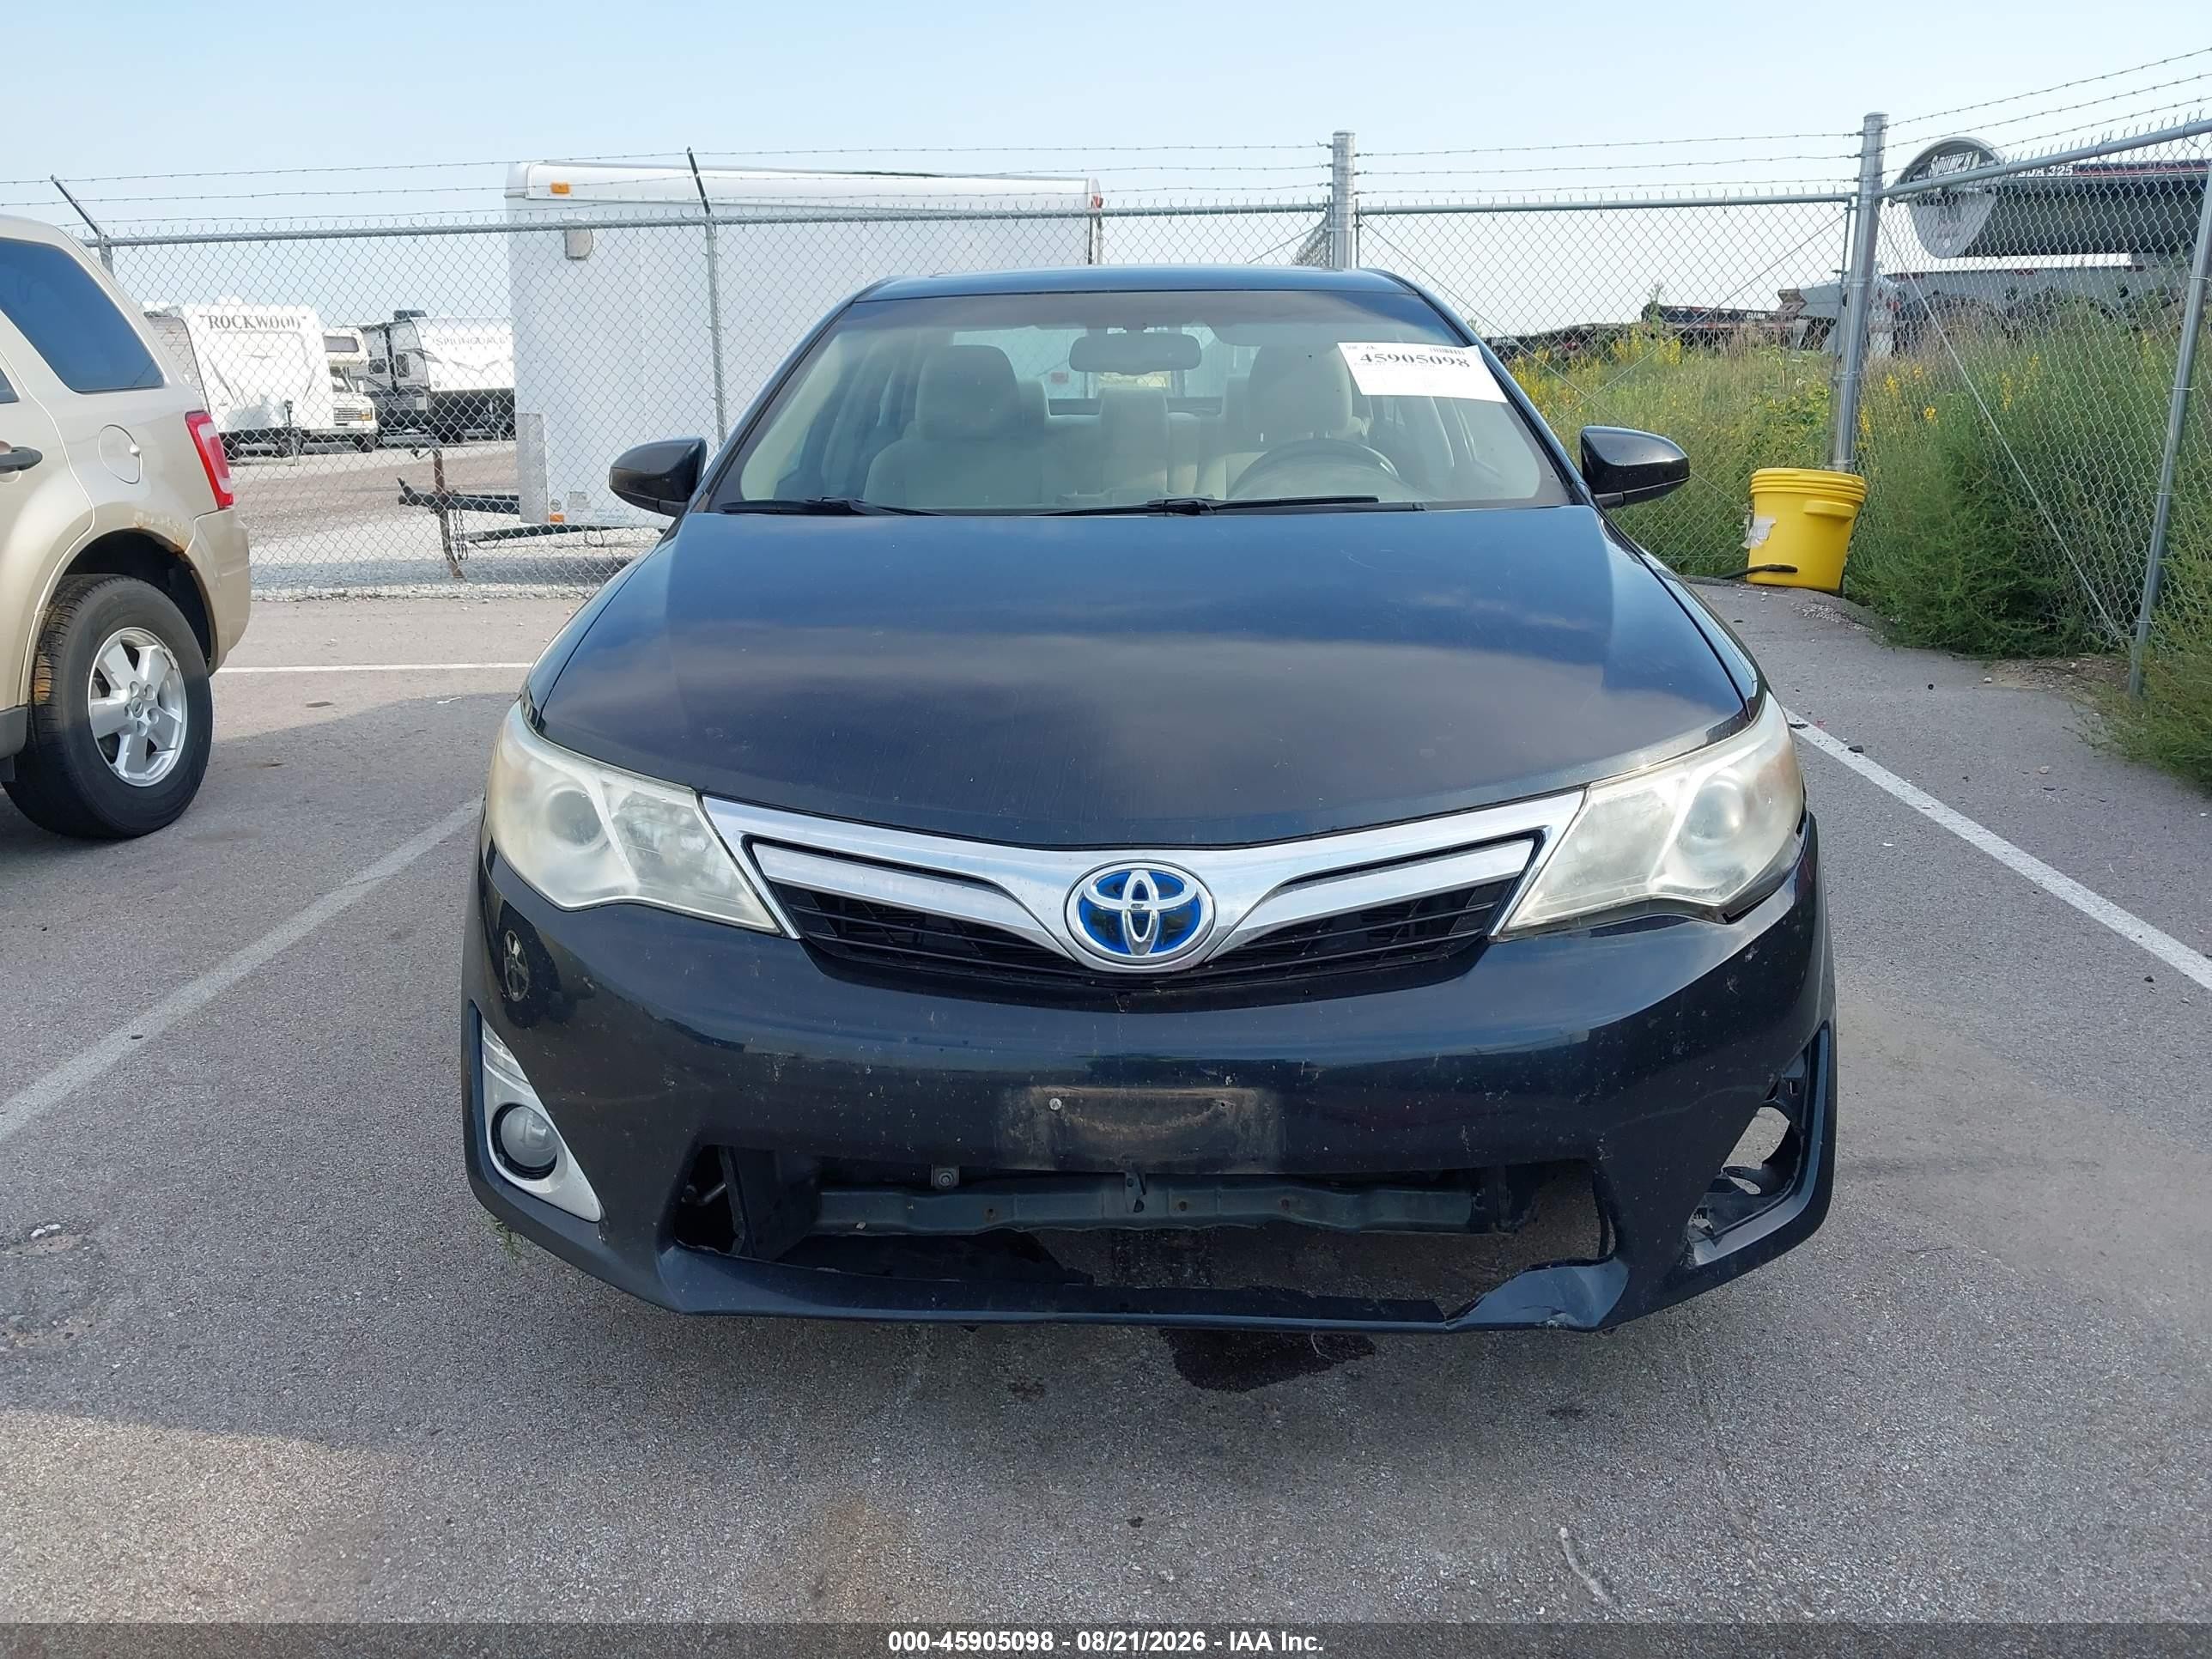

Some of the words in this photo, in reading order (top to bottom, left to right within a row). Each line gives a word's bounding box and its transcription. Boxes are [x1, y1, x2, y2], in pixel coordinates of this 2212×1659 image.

[2047, 165, 2074, 177] 325
[208, 314, 301, 330] ROCKWOOD
[1359, 352, 1471, 368] 45905098
